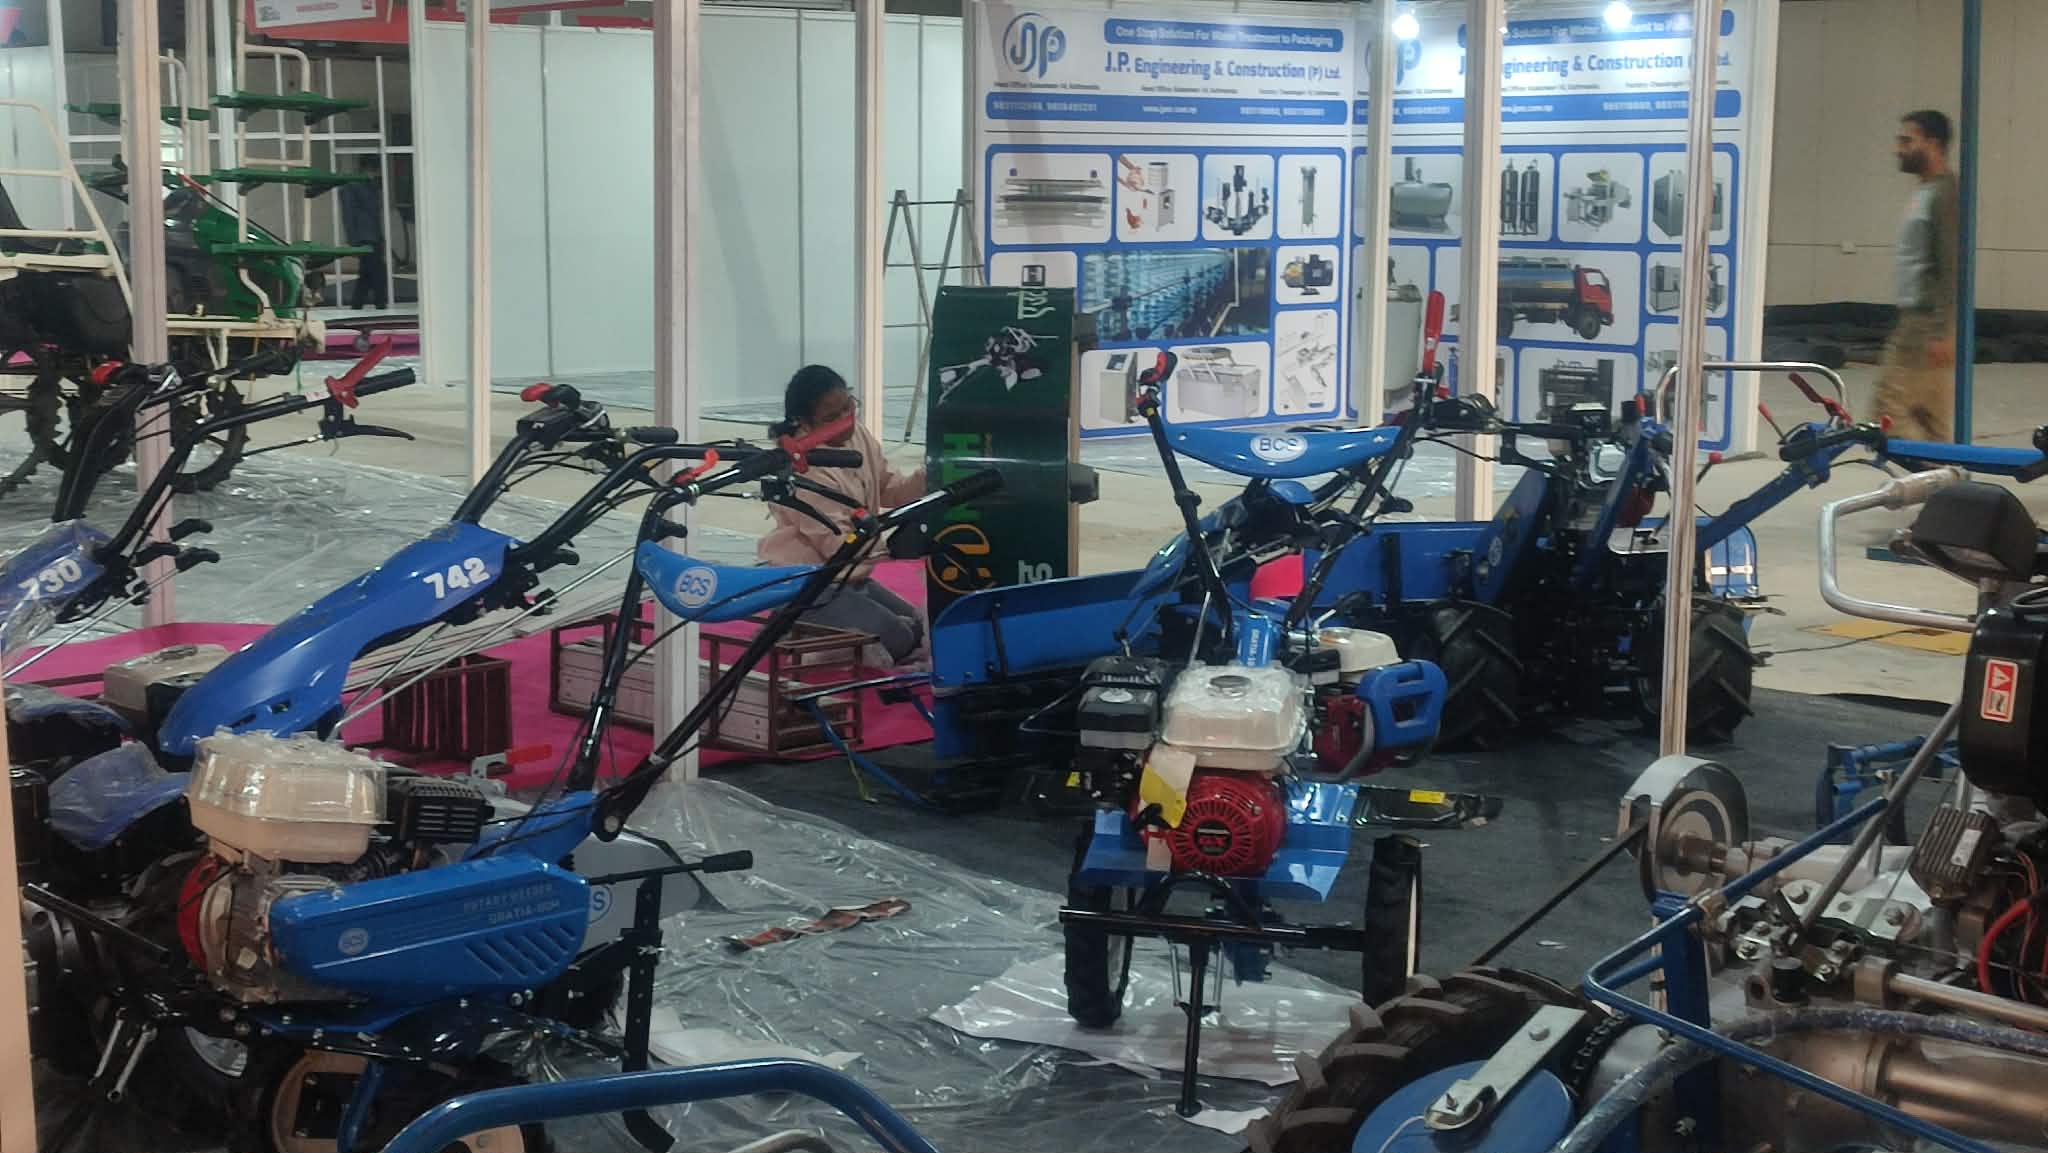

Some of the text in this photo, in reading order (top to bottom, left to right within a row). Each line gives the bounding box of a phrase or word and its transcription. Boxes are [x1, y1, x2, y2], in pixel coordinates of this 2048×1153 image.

[1115, 26, 1135, 37] One
[1136, 27, 1158, 39] Stop
[1159, 28, 1194, 39] Solution
[1194, 30, 1209, 40] For
[1237, 31, 1280, 43] Treatment
[1281, 33, 1290, 43] to
[1291, 34, 1333, 47] Packaging
[1104, 52, 1131, 73] J.P.
[1135, 57, 1211, 80] Engineering
[1214, 60, 1223, 76] &
[1227, 61, 1306, 79] Construction
[1325, 66, 1341, 79] Ltd.
[1504, 56, 1568, 79] gineering
[1573, 56, 1583, 71] &
[1588, 52, 1683, 70] Construction
[1260, 438, 1298, 451] BCS
[18, 559, 82, 601] 730
[422, 557, 491, 600] 742
[679, 573, 712, 597] BCS
